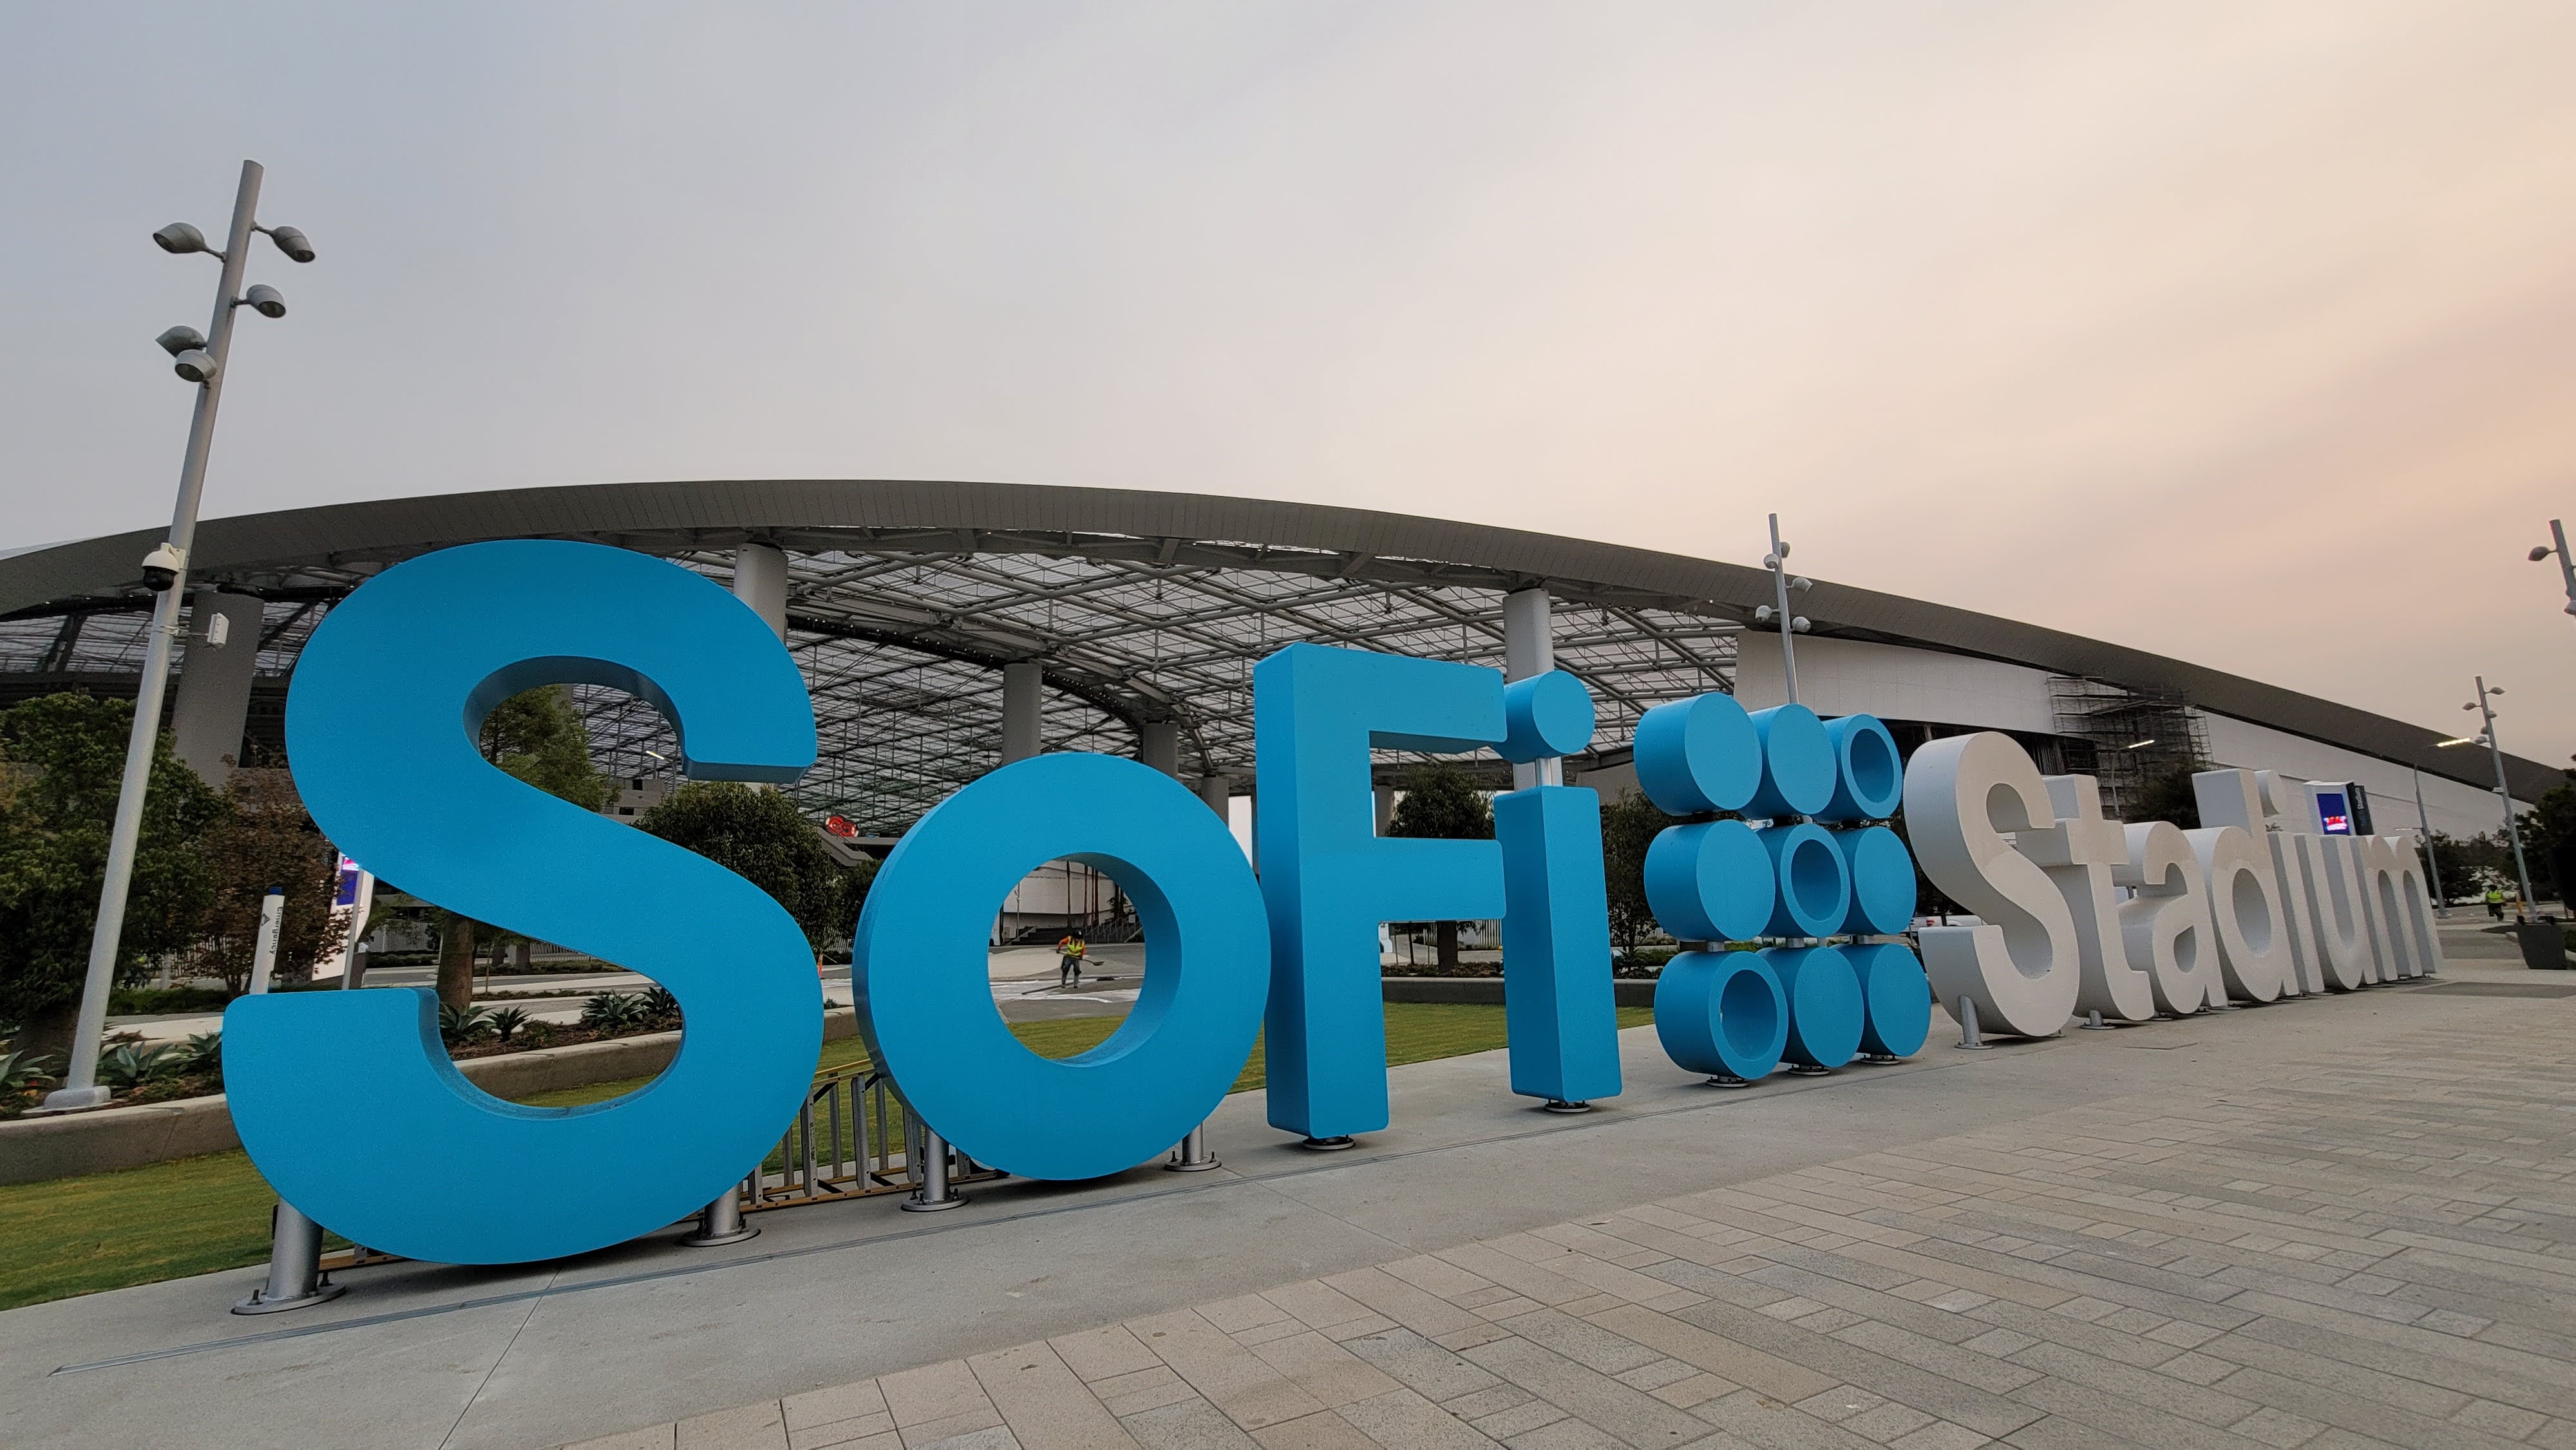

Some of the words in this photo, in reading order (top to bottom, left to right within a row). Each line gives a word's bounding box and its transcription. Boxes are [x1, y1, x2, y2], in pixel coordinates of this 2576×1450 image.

[223, 540, 1622, 1264] SoFi
[1904, 731, 2443, 1037] Stadium
[269, 906, 283, 954] Emergency
